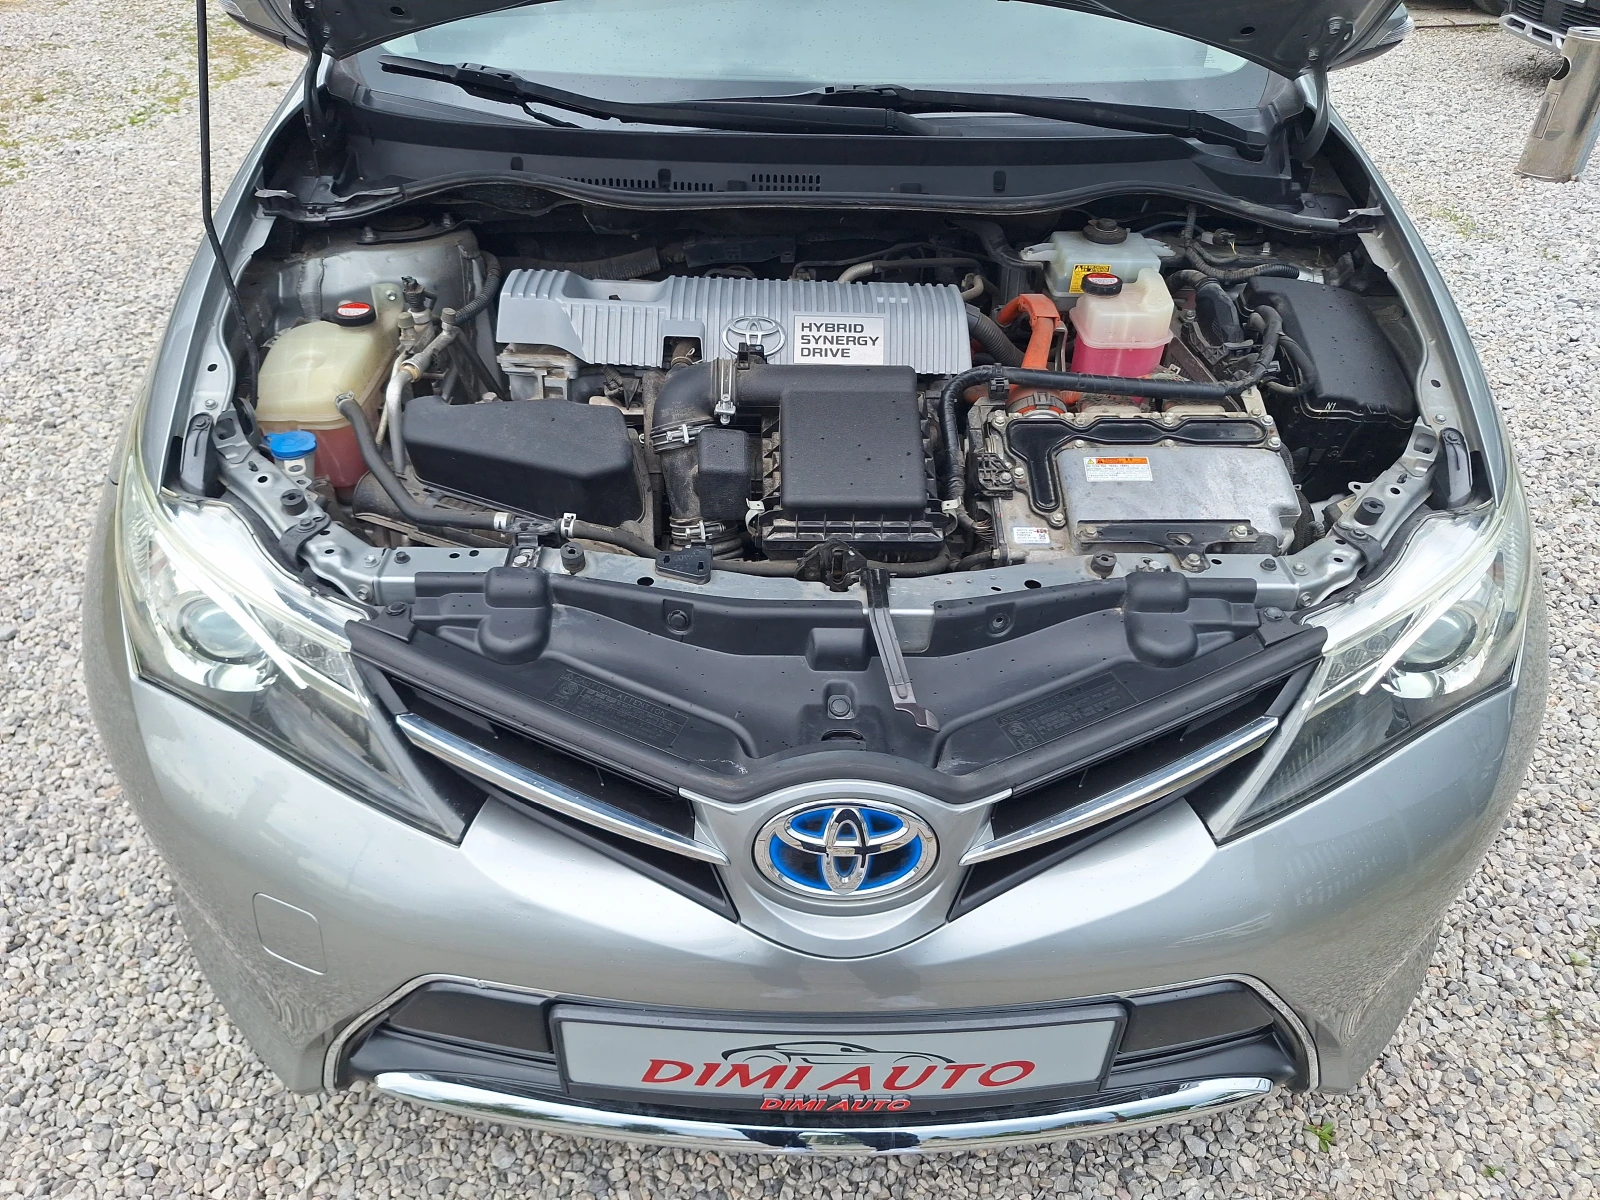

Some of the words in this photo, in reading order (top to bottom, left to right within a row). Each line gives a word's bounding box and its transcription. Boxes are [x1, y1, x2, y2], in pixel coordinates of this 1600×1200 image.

[801, 322, 864, 333] HYBRID
[800, 334, 879, 346] SYNERGY
[800, 347, 850, 358] DRIVE
[574, 677, 613, 696] CAUTION
[616, 693, 667, 717] ATTENTION
[641, 1058, 813, 1090] DIMI
[817, 1060, 1036, 1091] AUTO
[760, 1096, 829, 1111] DIMI
[826, 1097, 911, 1112] AUTO
